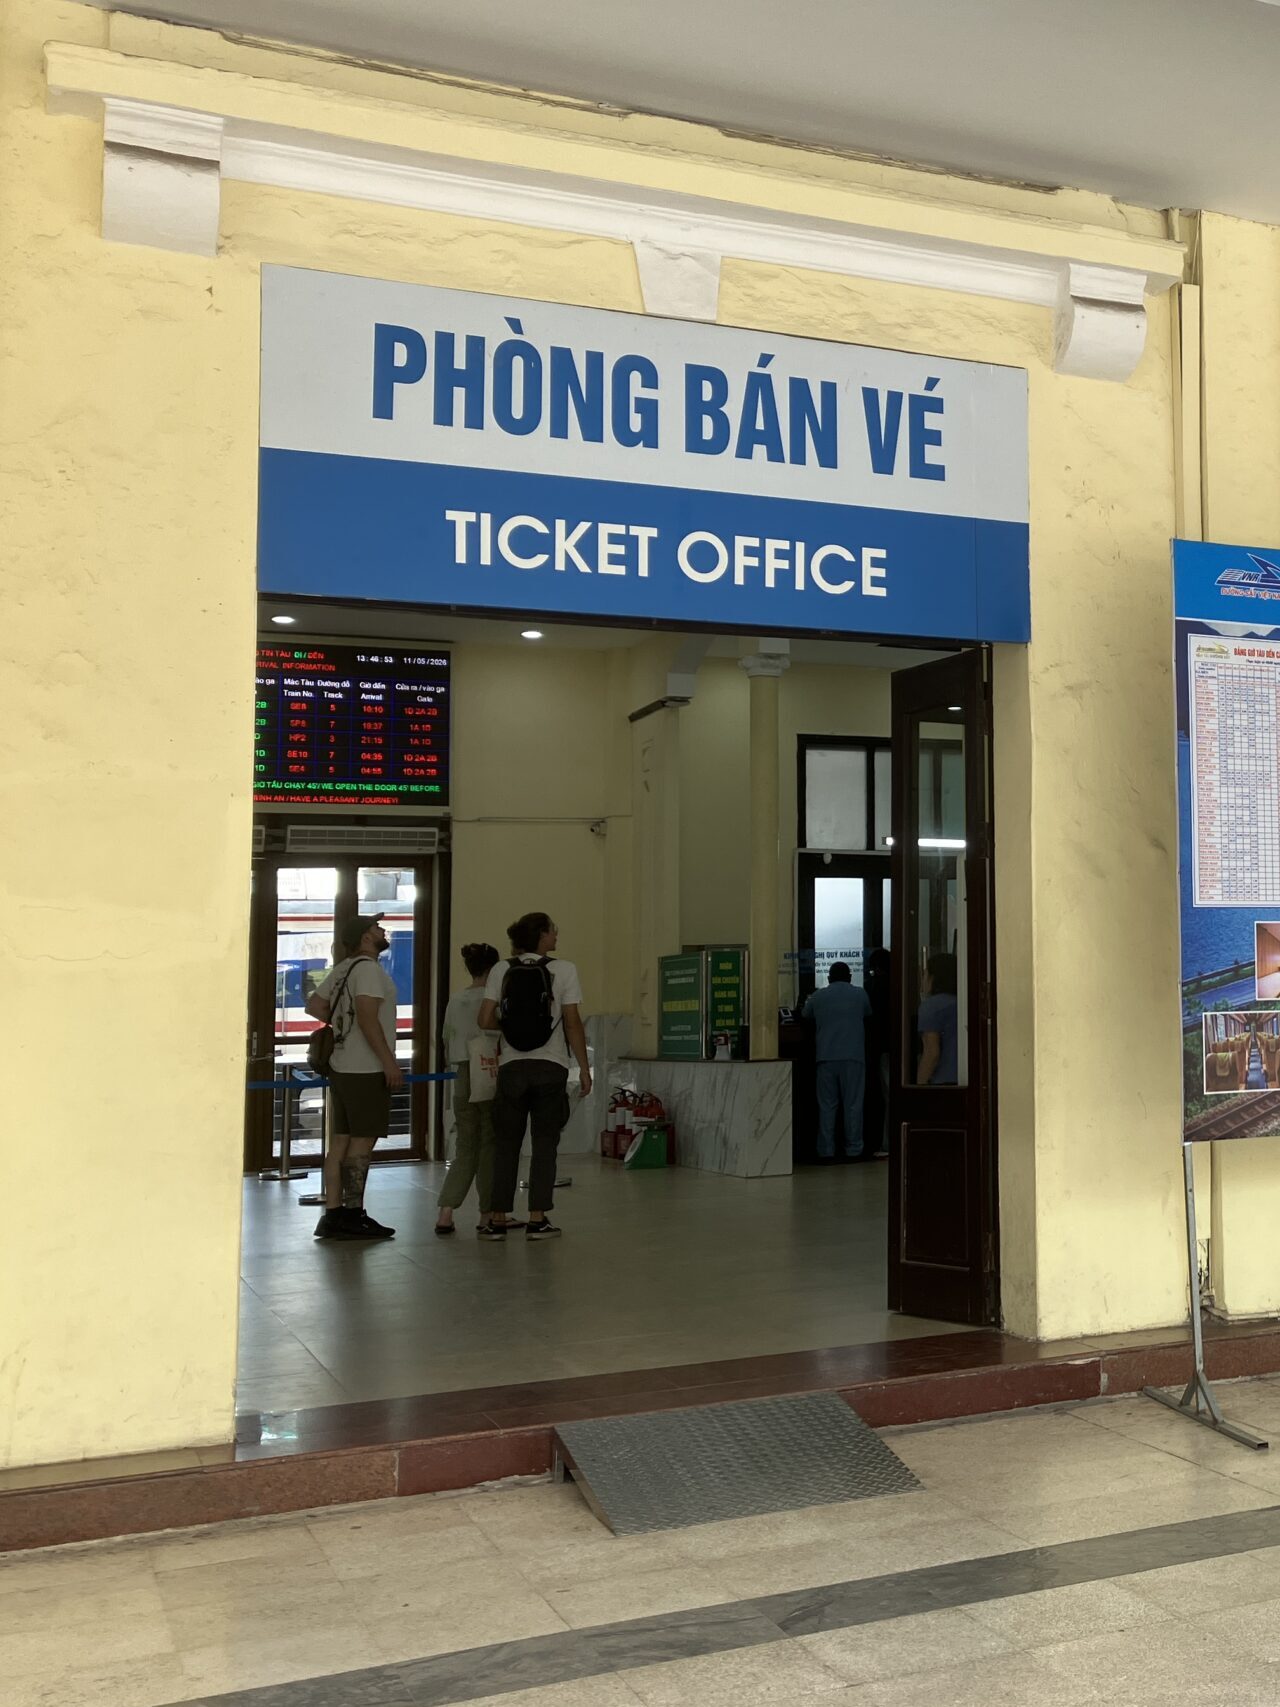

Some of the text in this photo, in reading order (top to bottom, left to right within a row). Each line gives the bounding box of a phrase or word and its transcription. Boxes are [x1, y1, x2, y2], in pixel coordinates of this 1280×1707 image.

[371, 316, 946, 482] PHÒNG BÁN VÉ
[444, 509, 888, 597] TICKET OFFICE
[256, 661, 337, 672] RIVAL INFORMATION
[265, 678, 275, 686] ga
[317, 679, 340, 689] Đường
[283, 689, 301, 697] Train
[323, 690, 343, 699] Track
[360, 693, 383, 701] Arrival
[417, 695, 433, 703] Gate
[284, 781, 306, 790] CHẠY
[335, 783, 357, 791] OPEN
[319, 796, 360, 804] PLEASANT
[826, 950, 838, 959] QUÝ
[839, 950, 860, 959] KHÁCH
